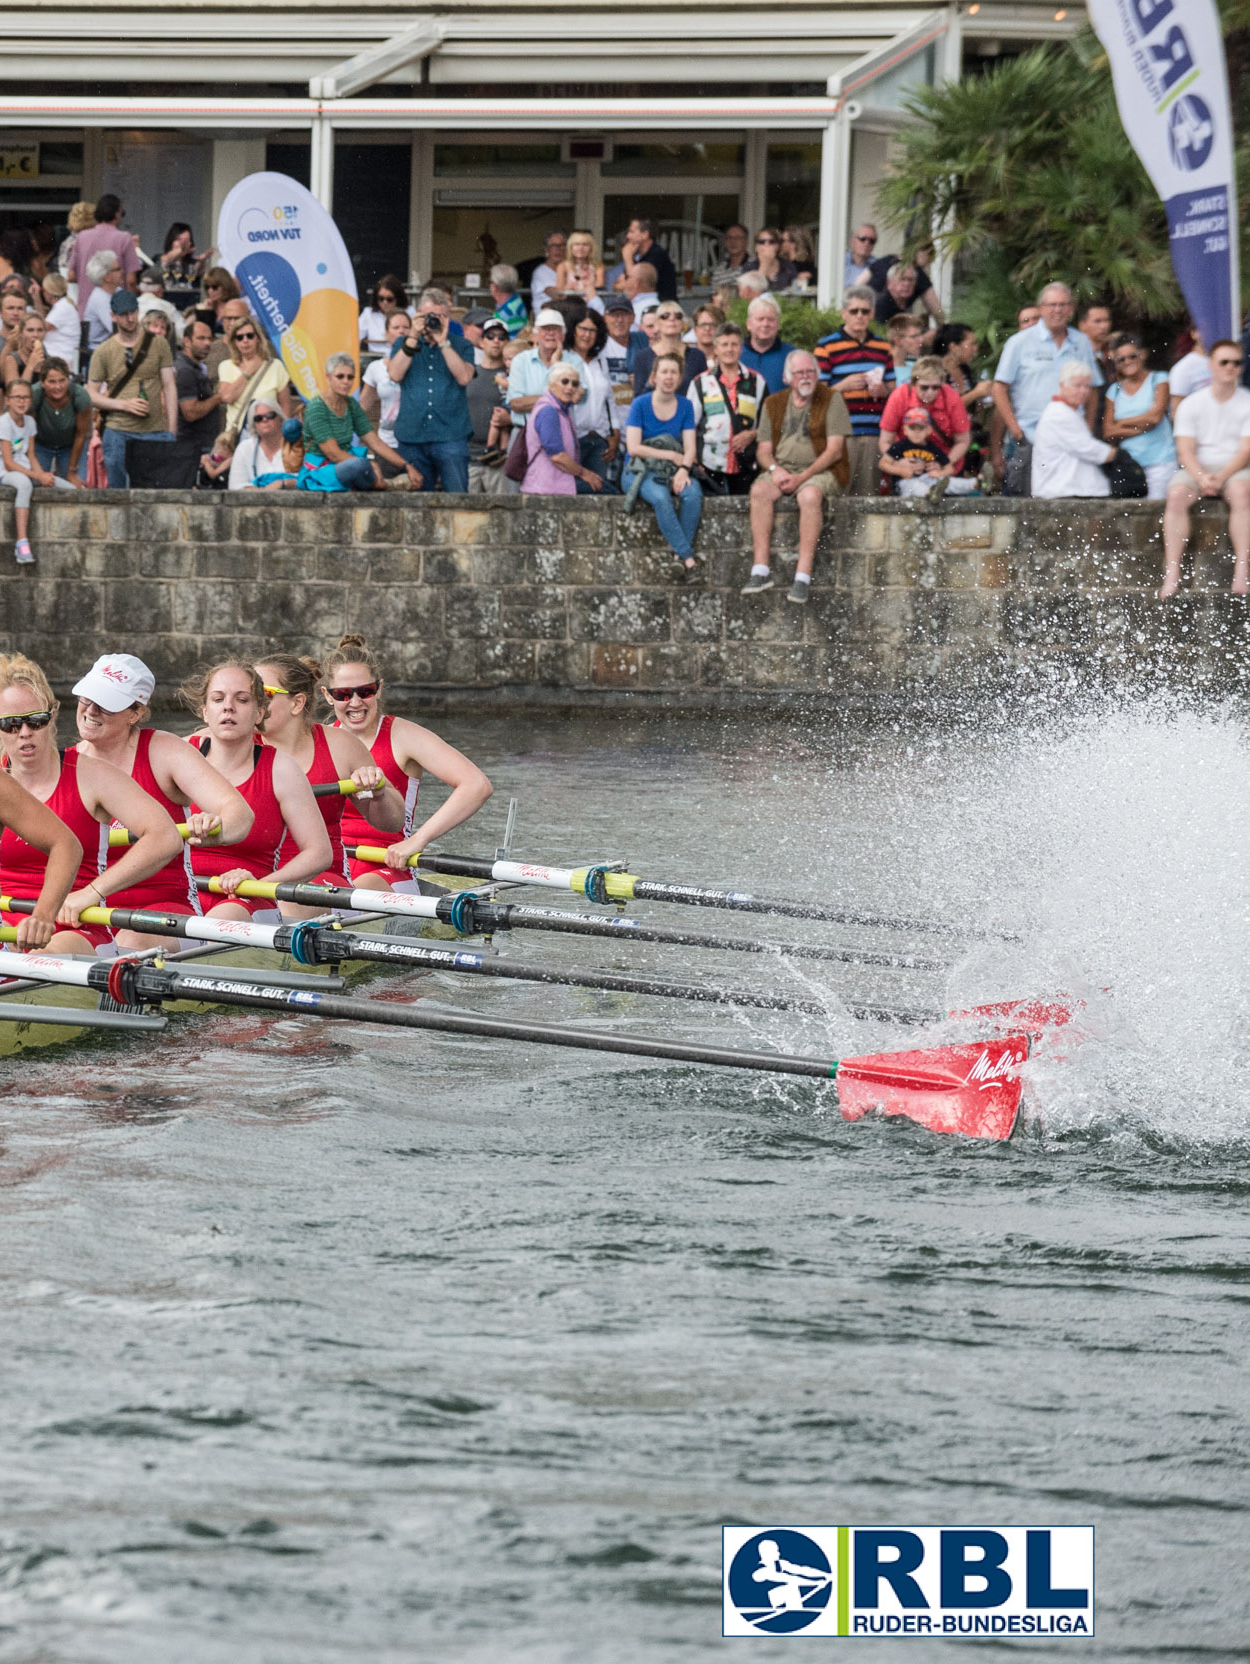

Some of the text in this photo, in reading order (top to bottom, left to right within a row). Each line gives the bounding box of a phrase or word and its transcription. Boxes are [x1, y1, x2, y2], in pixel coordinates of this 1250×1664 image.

[640, 881, 667, 892] STARK.
[668, 885, 705, 897] SCHNELL.
[705, 890, 724, 898] GUT.
[519, 907, 547, 916] STARK.
[548, 910, 589, 923] SCHNELL.
[589, 915, 608, 924] GUT.
[358, 940, 477, 964] STARK. SCHNELL. GUT. RBL
[182, 977, 314, 1002] STARK. SCHNELL. GUT. RBL
